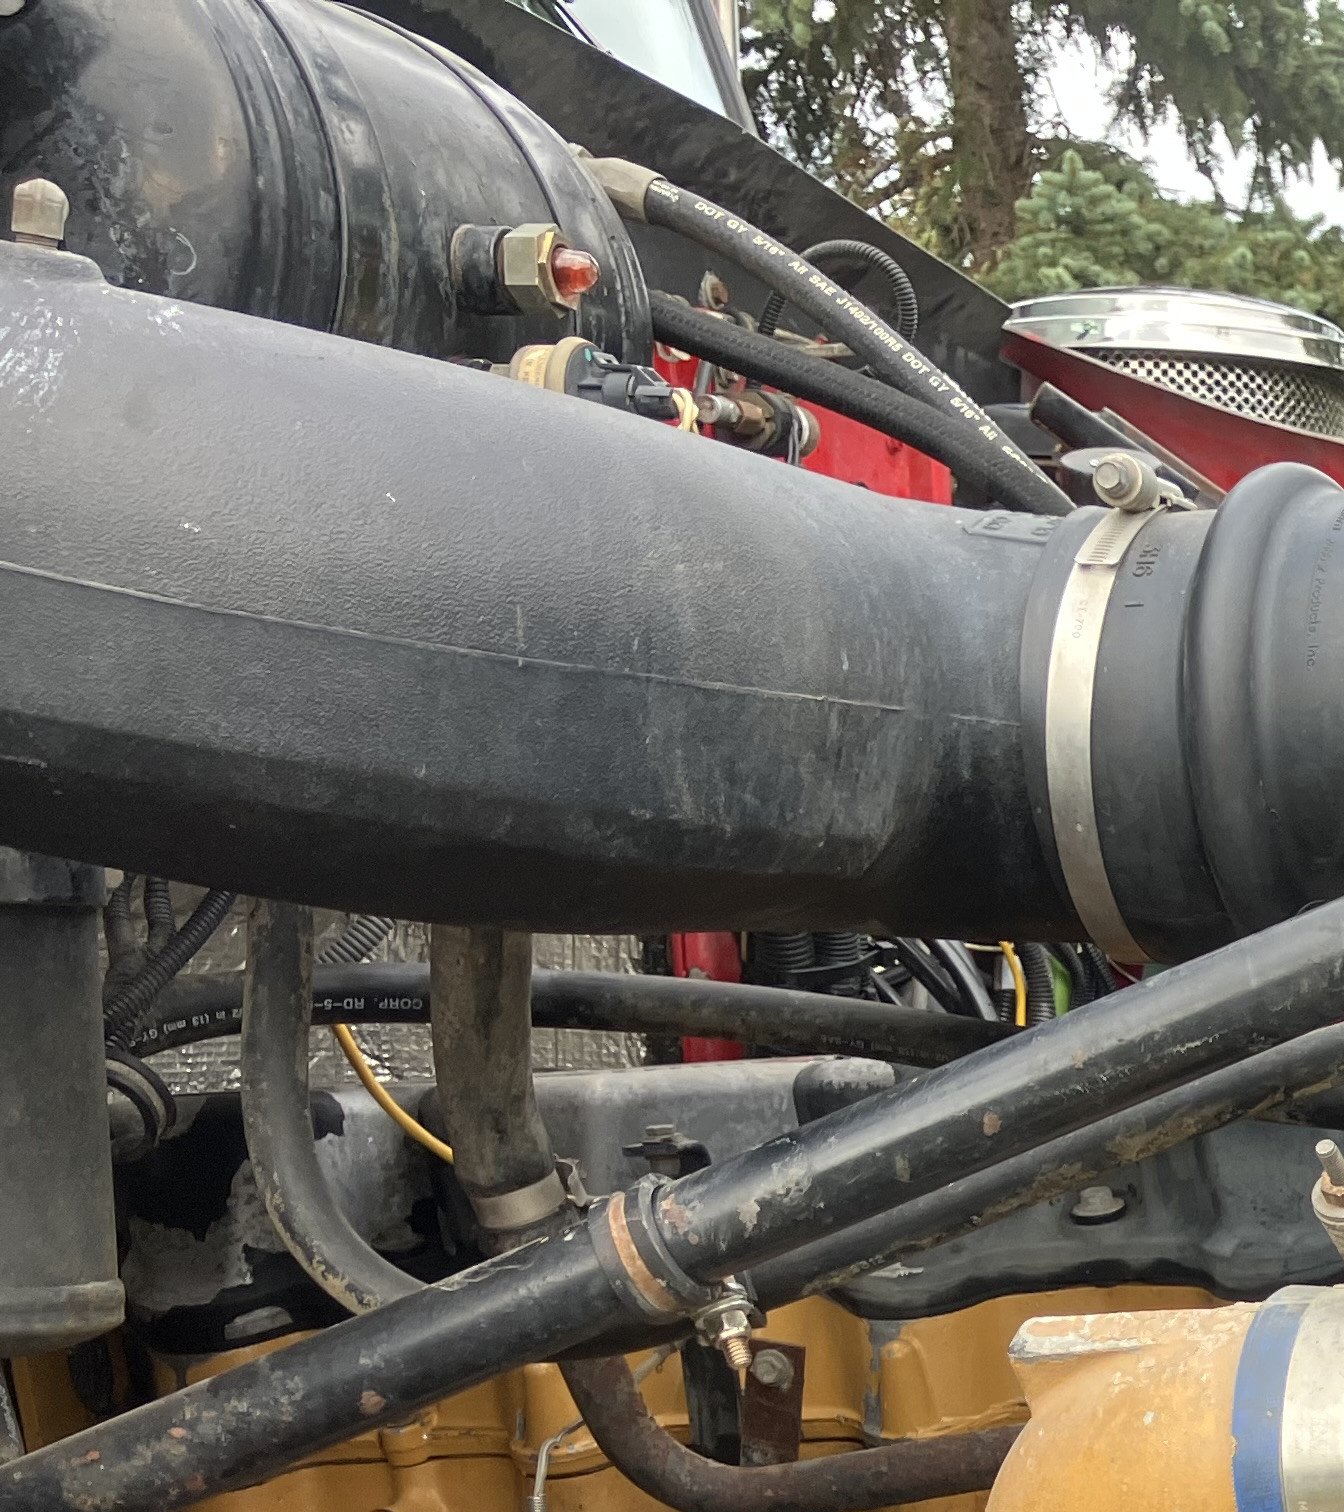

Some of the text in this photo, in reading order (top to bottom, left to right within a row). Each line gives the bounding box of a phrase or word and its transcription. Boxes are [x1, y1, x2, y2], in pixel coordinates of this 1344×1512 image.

[694, 201, 725, 220] DOT
[727, 218, 749, 234] GY
[809, 275, 838, 296] SAE
[901, 352, 931, 375] DOT
[929, 375, 950, 393] GY
[373, 997, 423, 1010] CORP.
